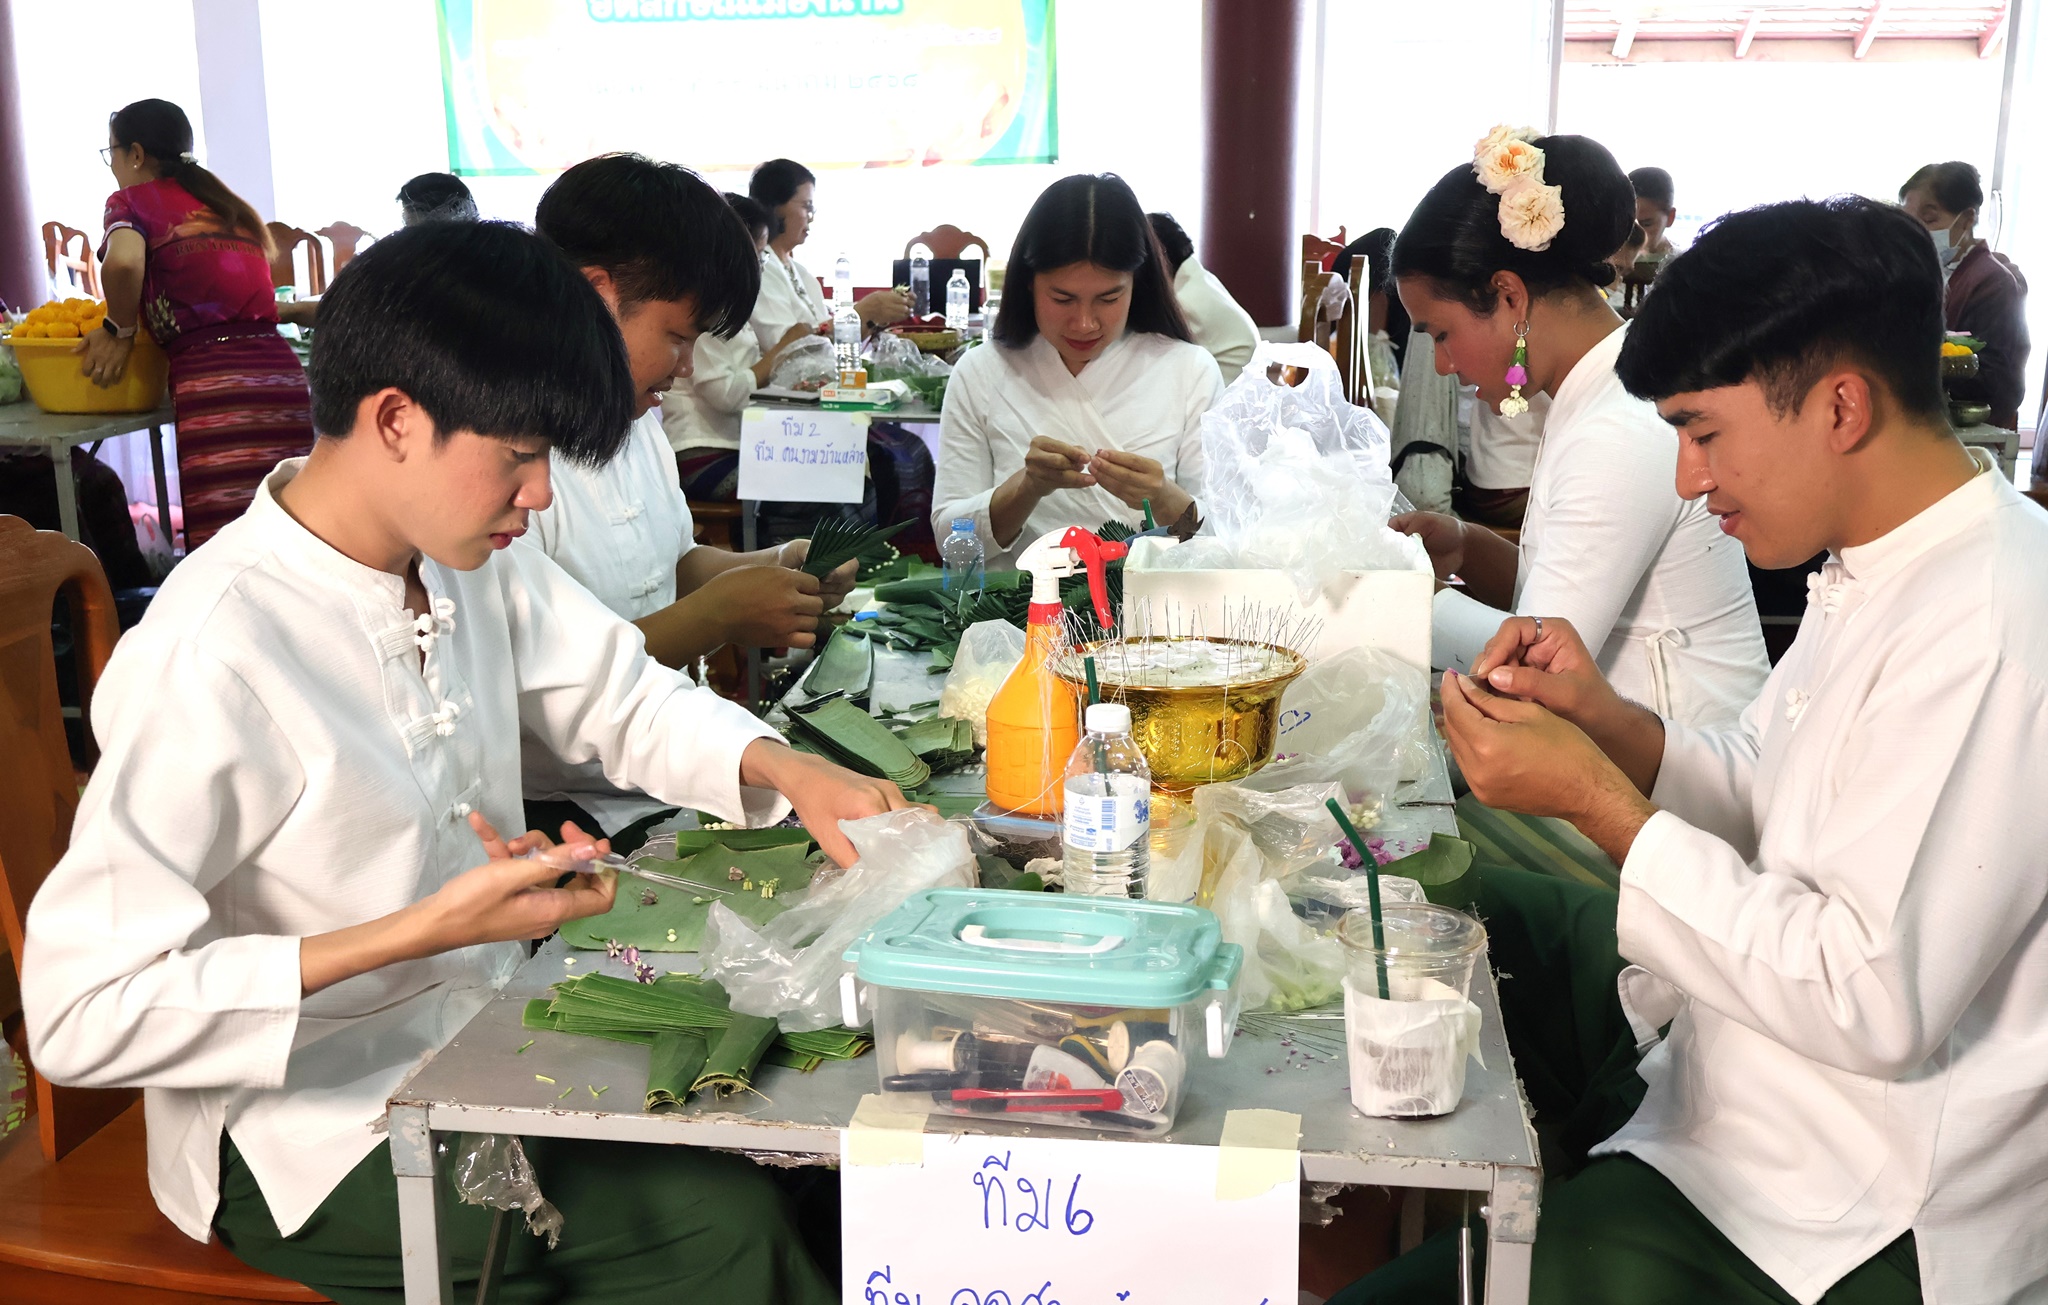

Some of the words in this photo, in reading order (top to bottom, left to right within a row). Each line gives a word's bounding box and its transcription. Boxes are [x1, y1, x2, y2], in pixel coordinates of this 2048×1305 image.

[781, 415, 804, 437] ทีม
[808, 422, 821, 437] 2
[754, 440, 775, 462] ทีม
